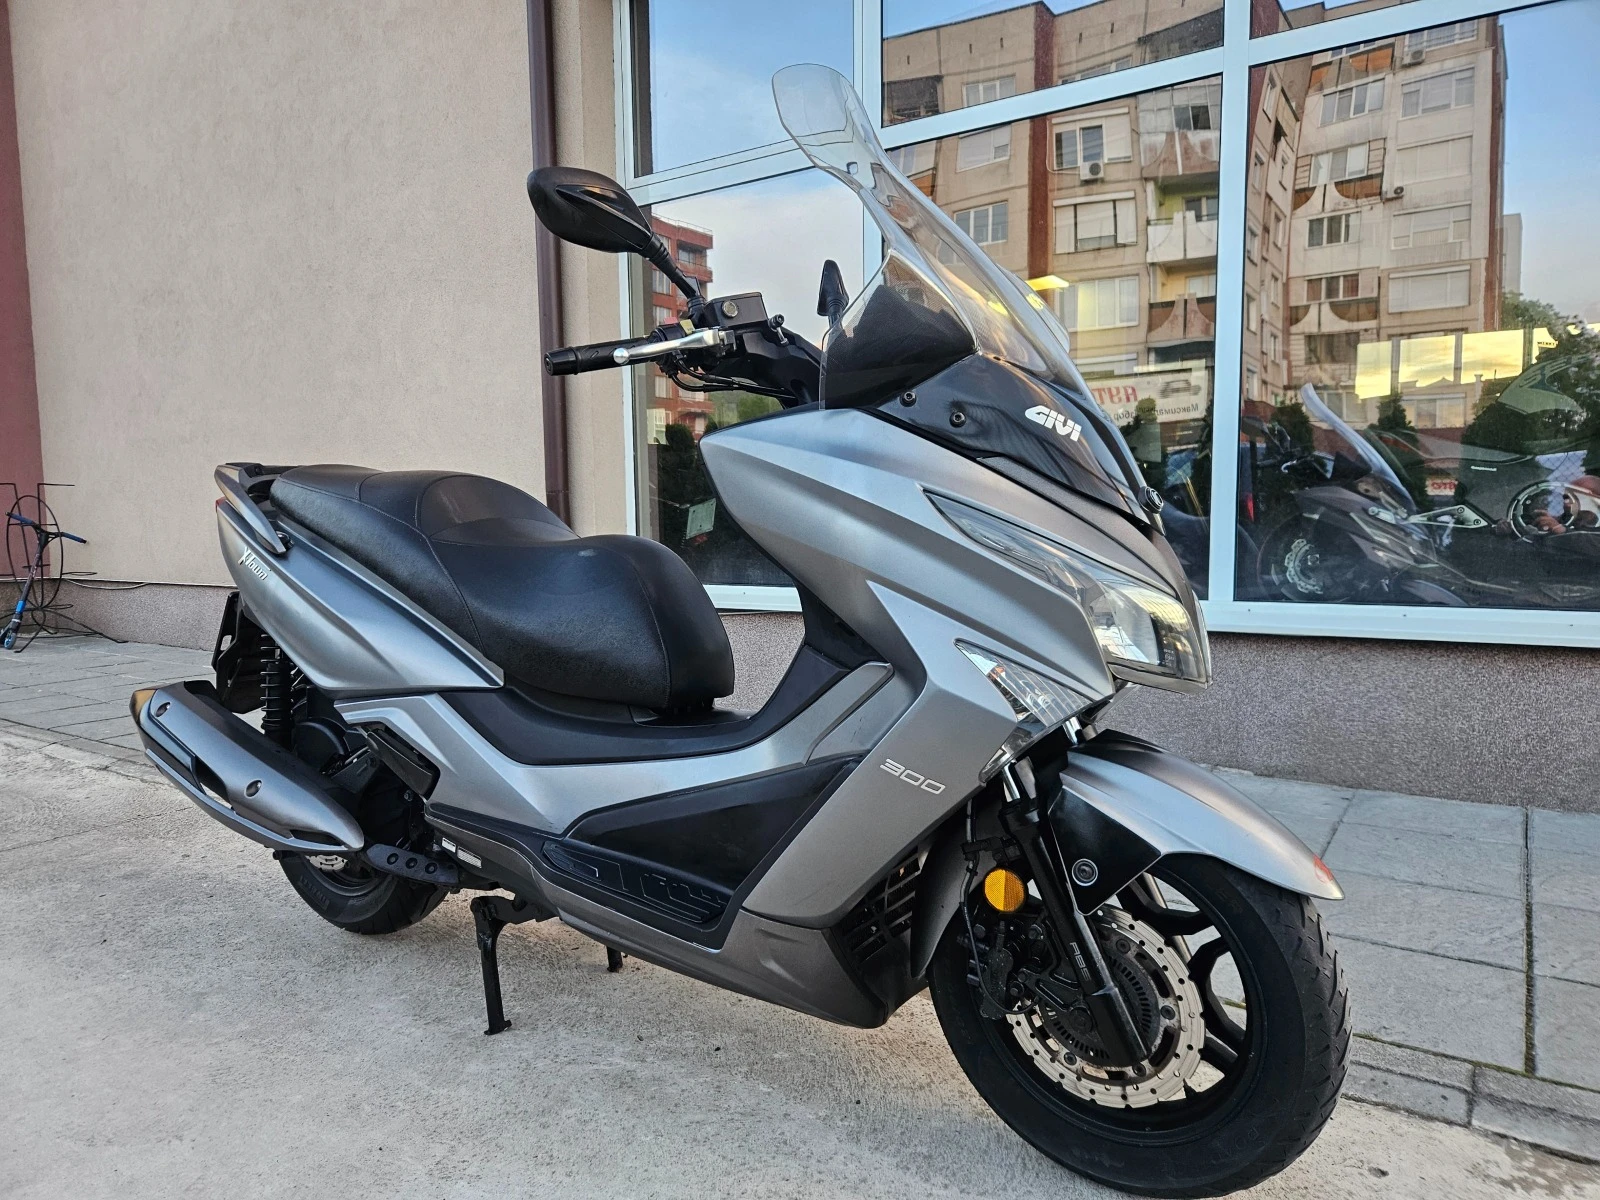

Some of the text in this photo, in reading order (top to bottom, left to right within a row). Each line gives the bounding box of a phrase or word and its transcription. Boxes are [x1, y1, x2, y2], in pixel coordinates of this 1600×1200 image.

[1024, 404, 1082, 442] GIVI
[879, 758, 946, 795] 300
[1069, 941, 1092, 982] ABS
